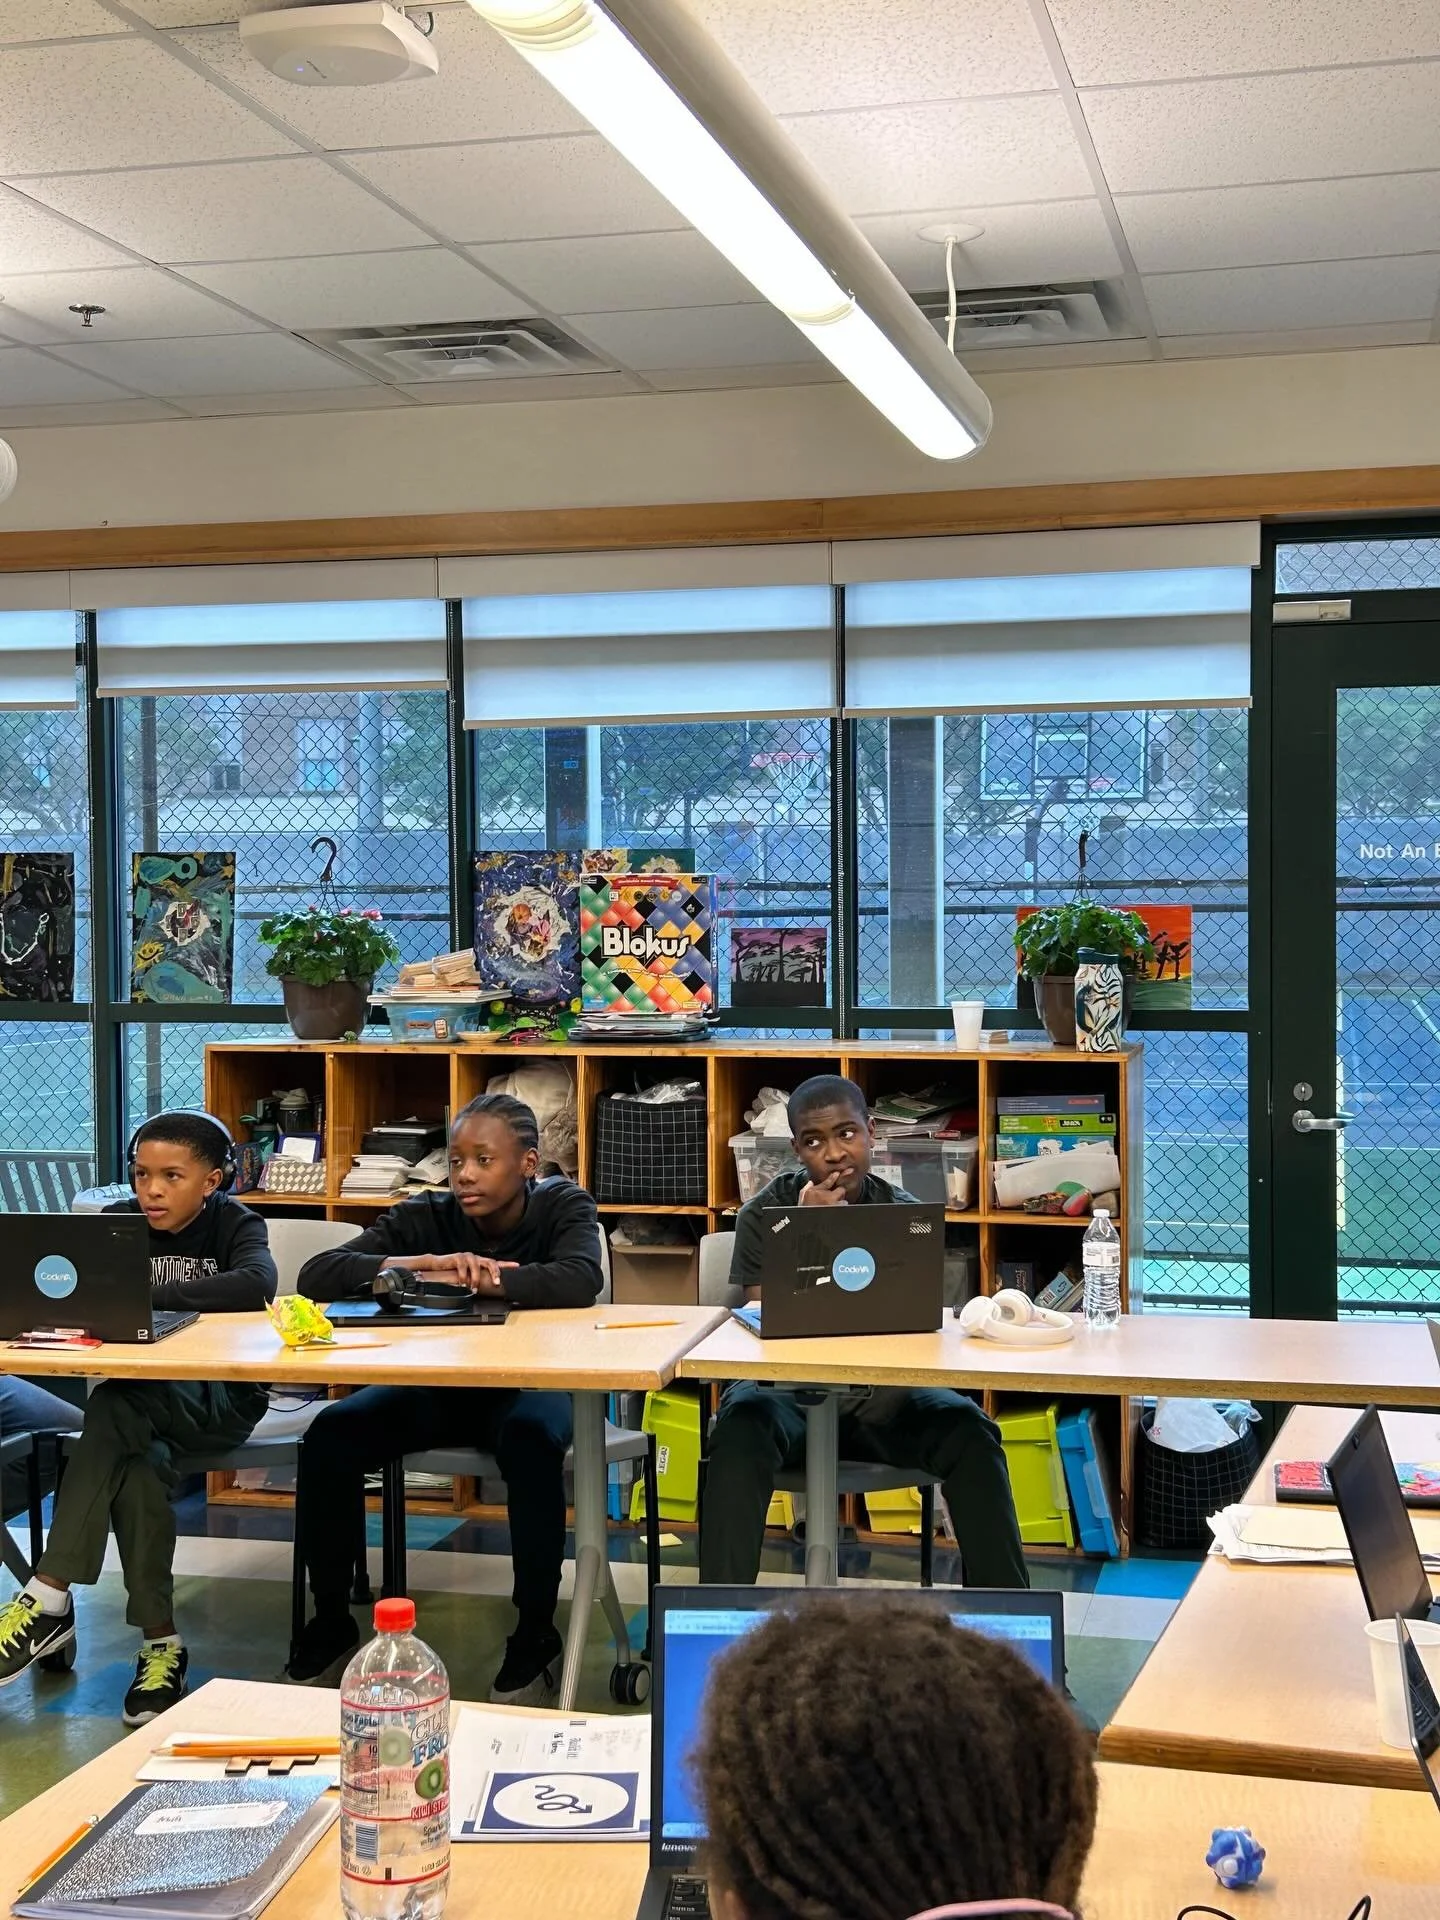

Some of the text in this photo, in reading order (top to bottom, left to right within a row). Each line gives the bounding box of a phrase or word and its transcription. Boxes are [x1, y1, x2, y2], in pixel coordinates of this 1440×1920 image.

[1360, 843, 1393, 859] Not
[1401, 843, 1426, 859] An
[603, 926, 690, 960] Blokus
[838, 1264, 870, 1274] CodeVA
[661, 1842, 698, 1852] lenovo
